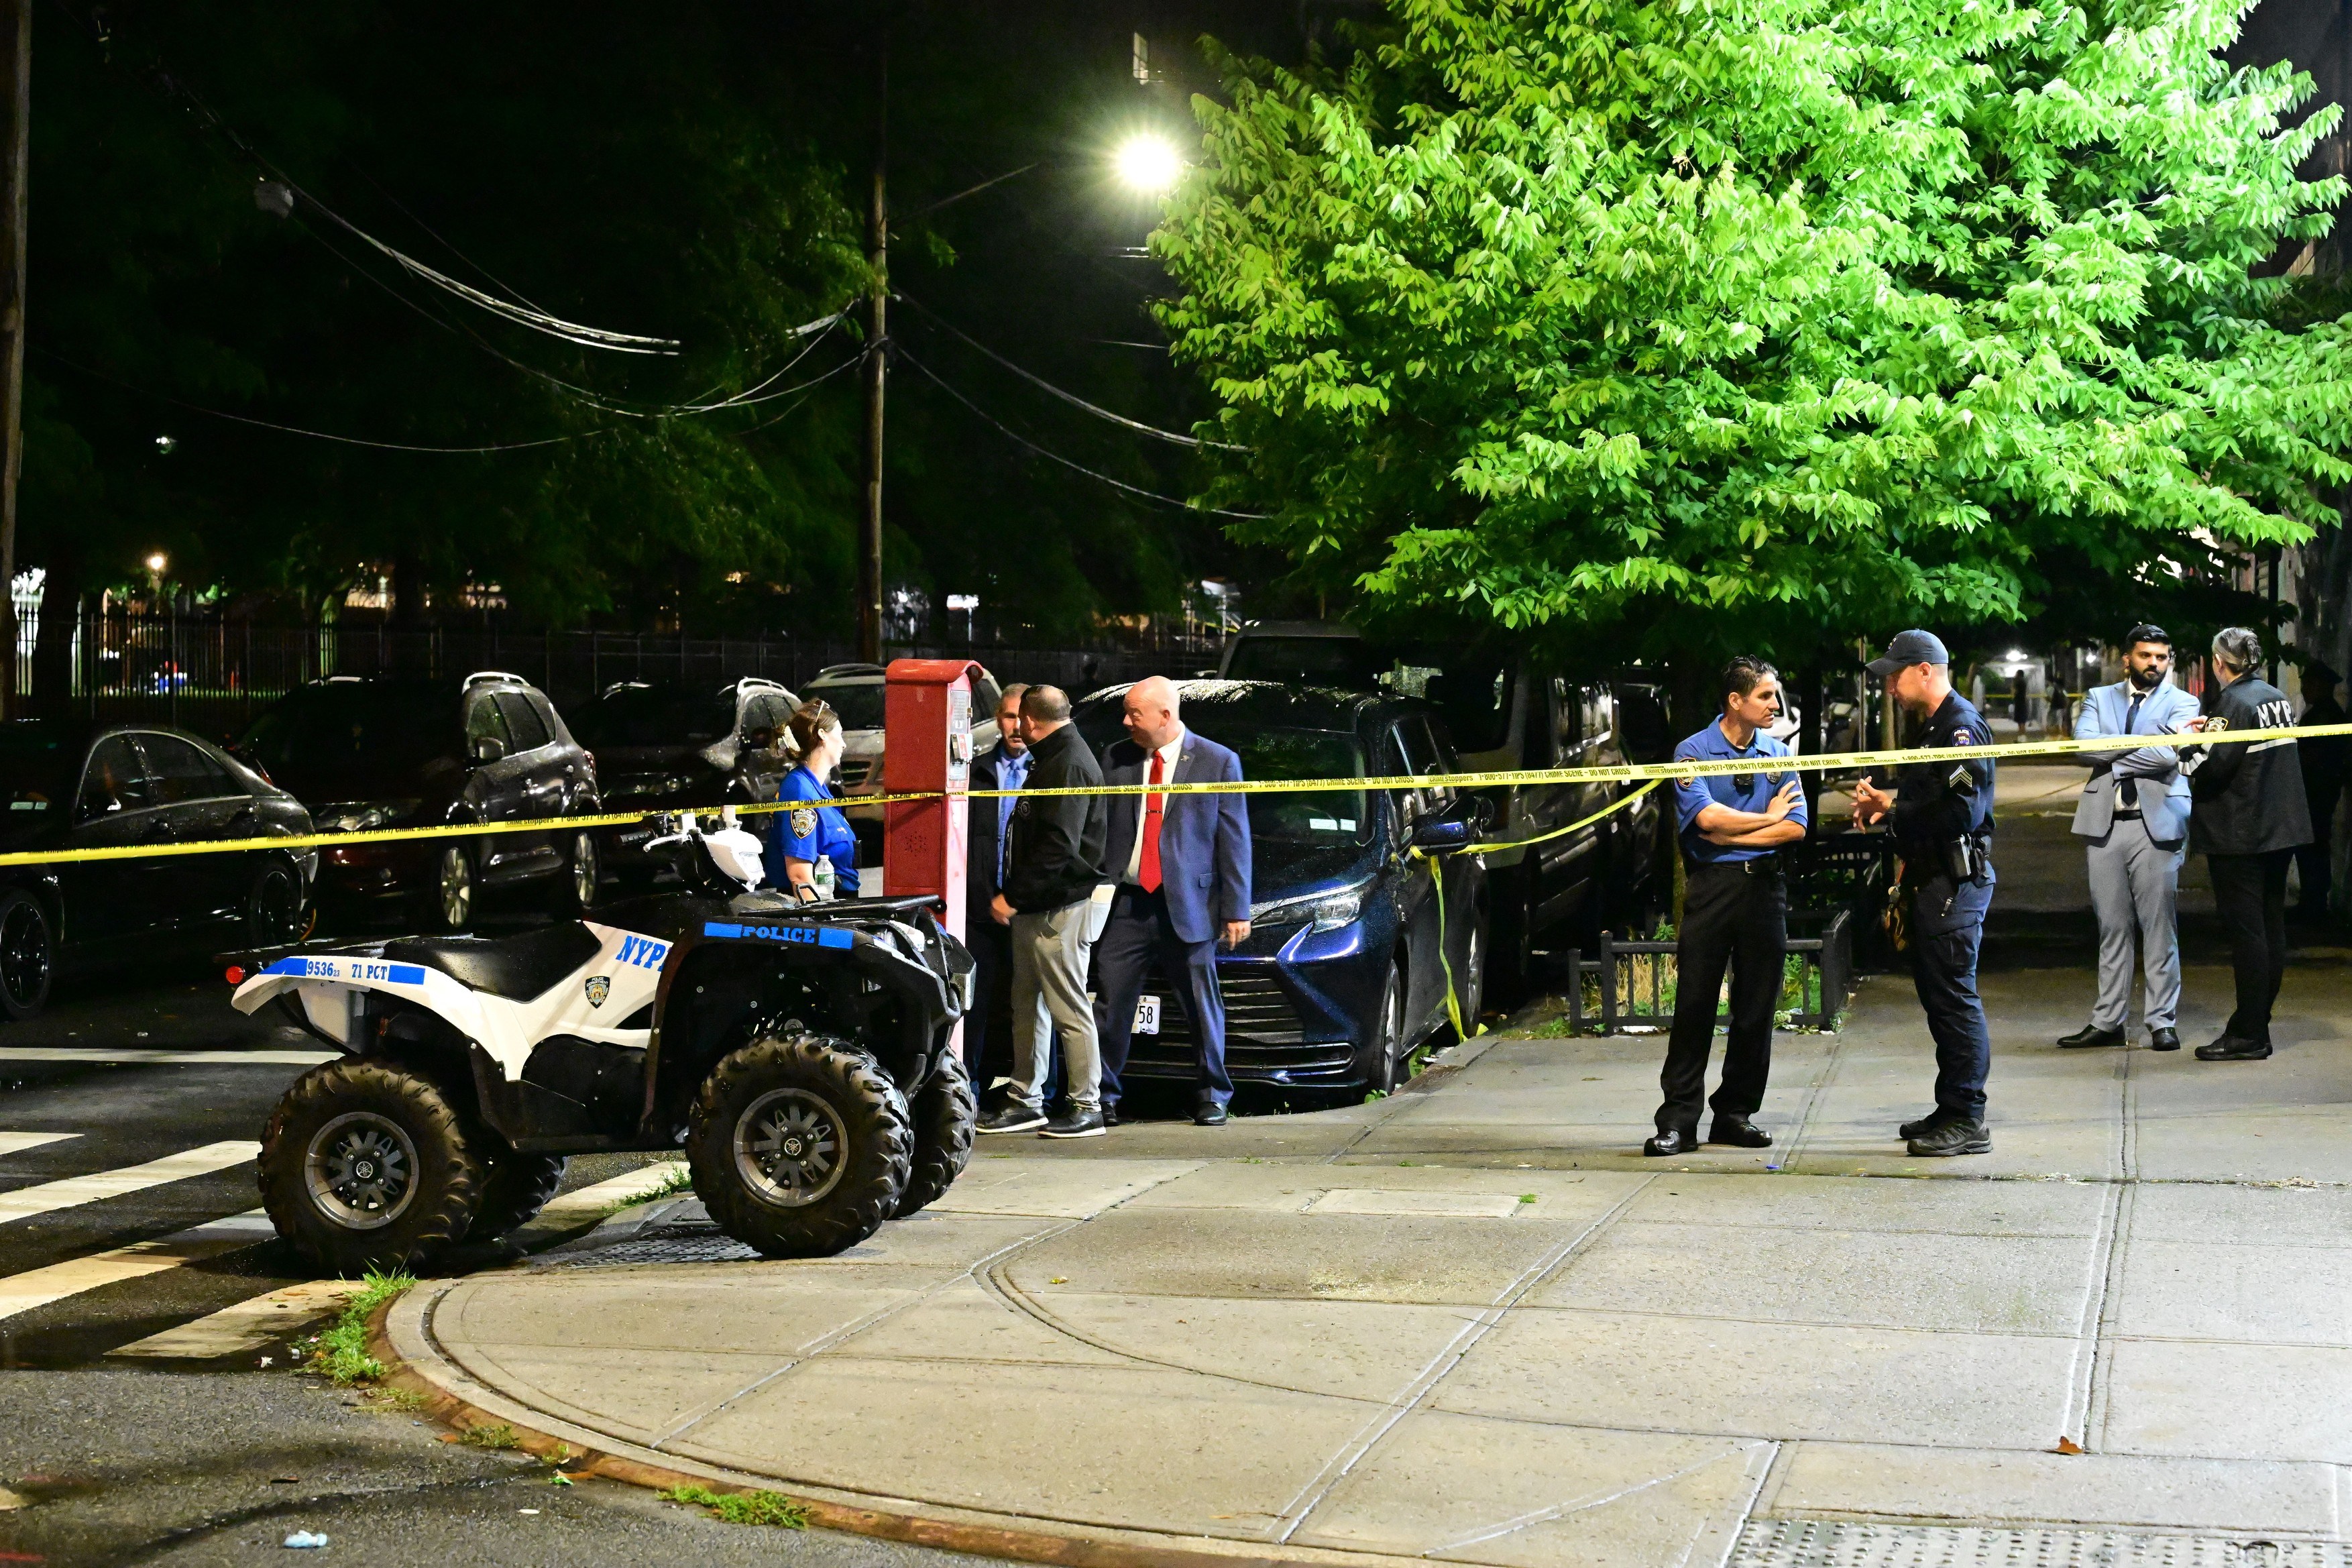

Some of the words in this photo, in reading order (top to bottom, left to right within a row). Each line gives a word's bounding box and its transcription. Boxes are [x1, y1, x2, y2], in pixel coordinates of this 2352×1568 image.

[1693, 763, 1738, 772] 1-800-577-TIPS
[1738, 763, 1756, 771] (8477)
[1327, 778, 1345, 786] CRIME
[1478, 772, 1524, 781] 1-800-577-TIPS
[1545, 771, 1563, 779] CRIME
[742, 926, 816, 944] POLICE
[306, 960, 334, 976] 9536
[351, 964, 363, 978] 71
[366, 965, 388, 980] PCT
[1139, 1005, 1153, 1024] 58
